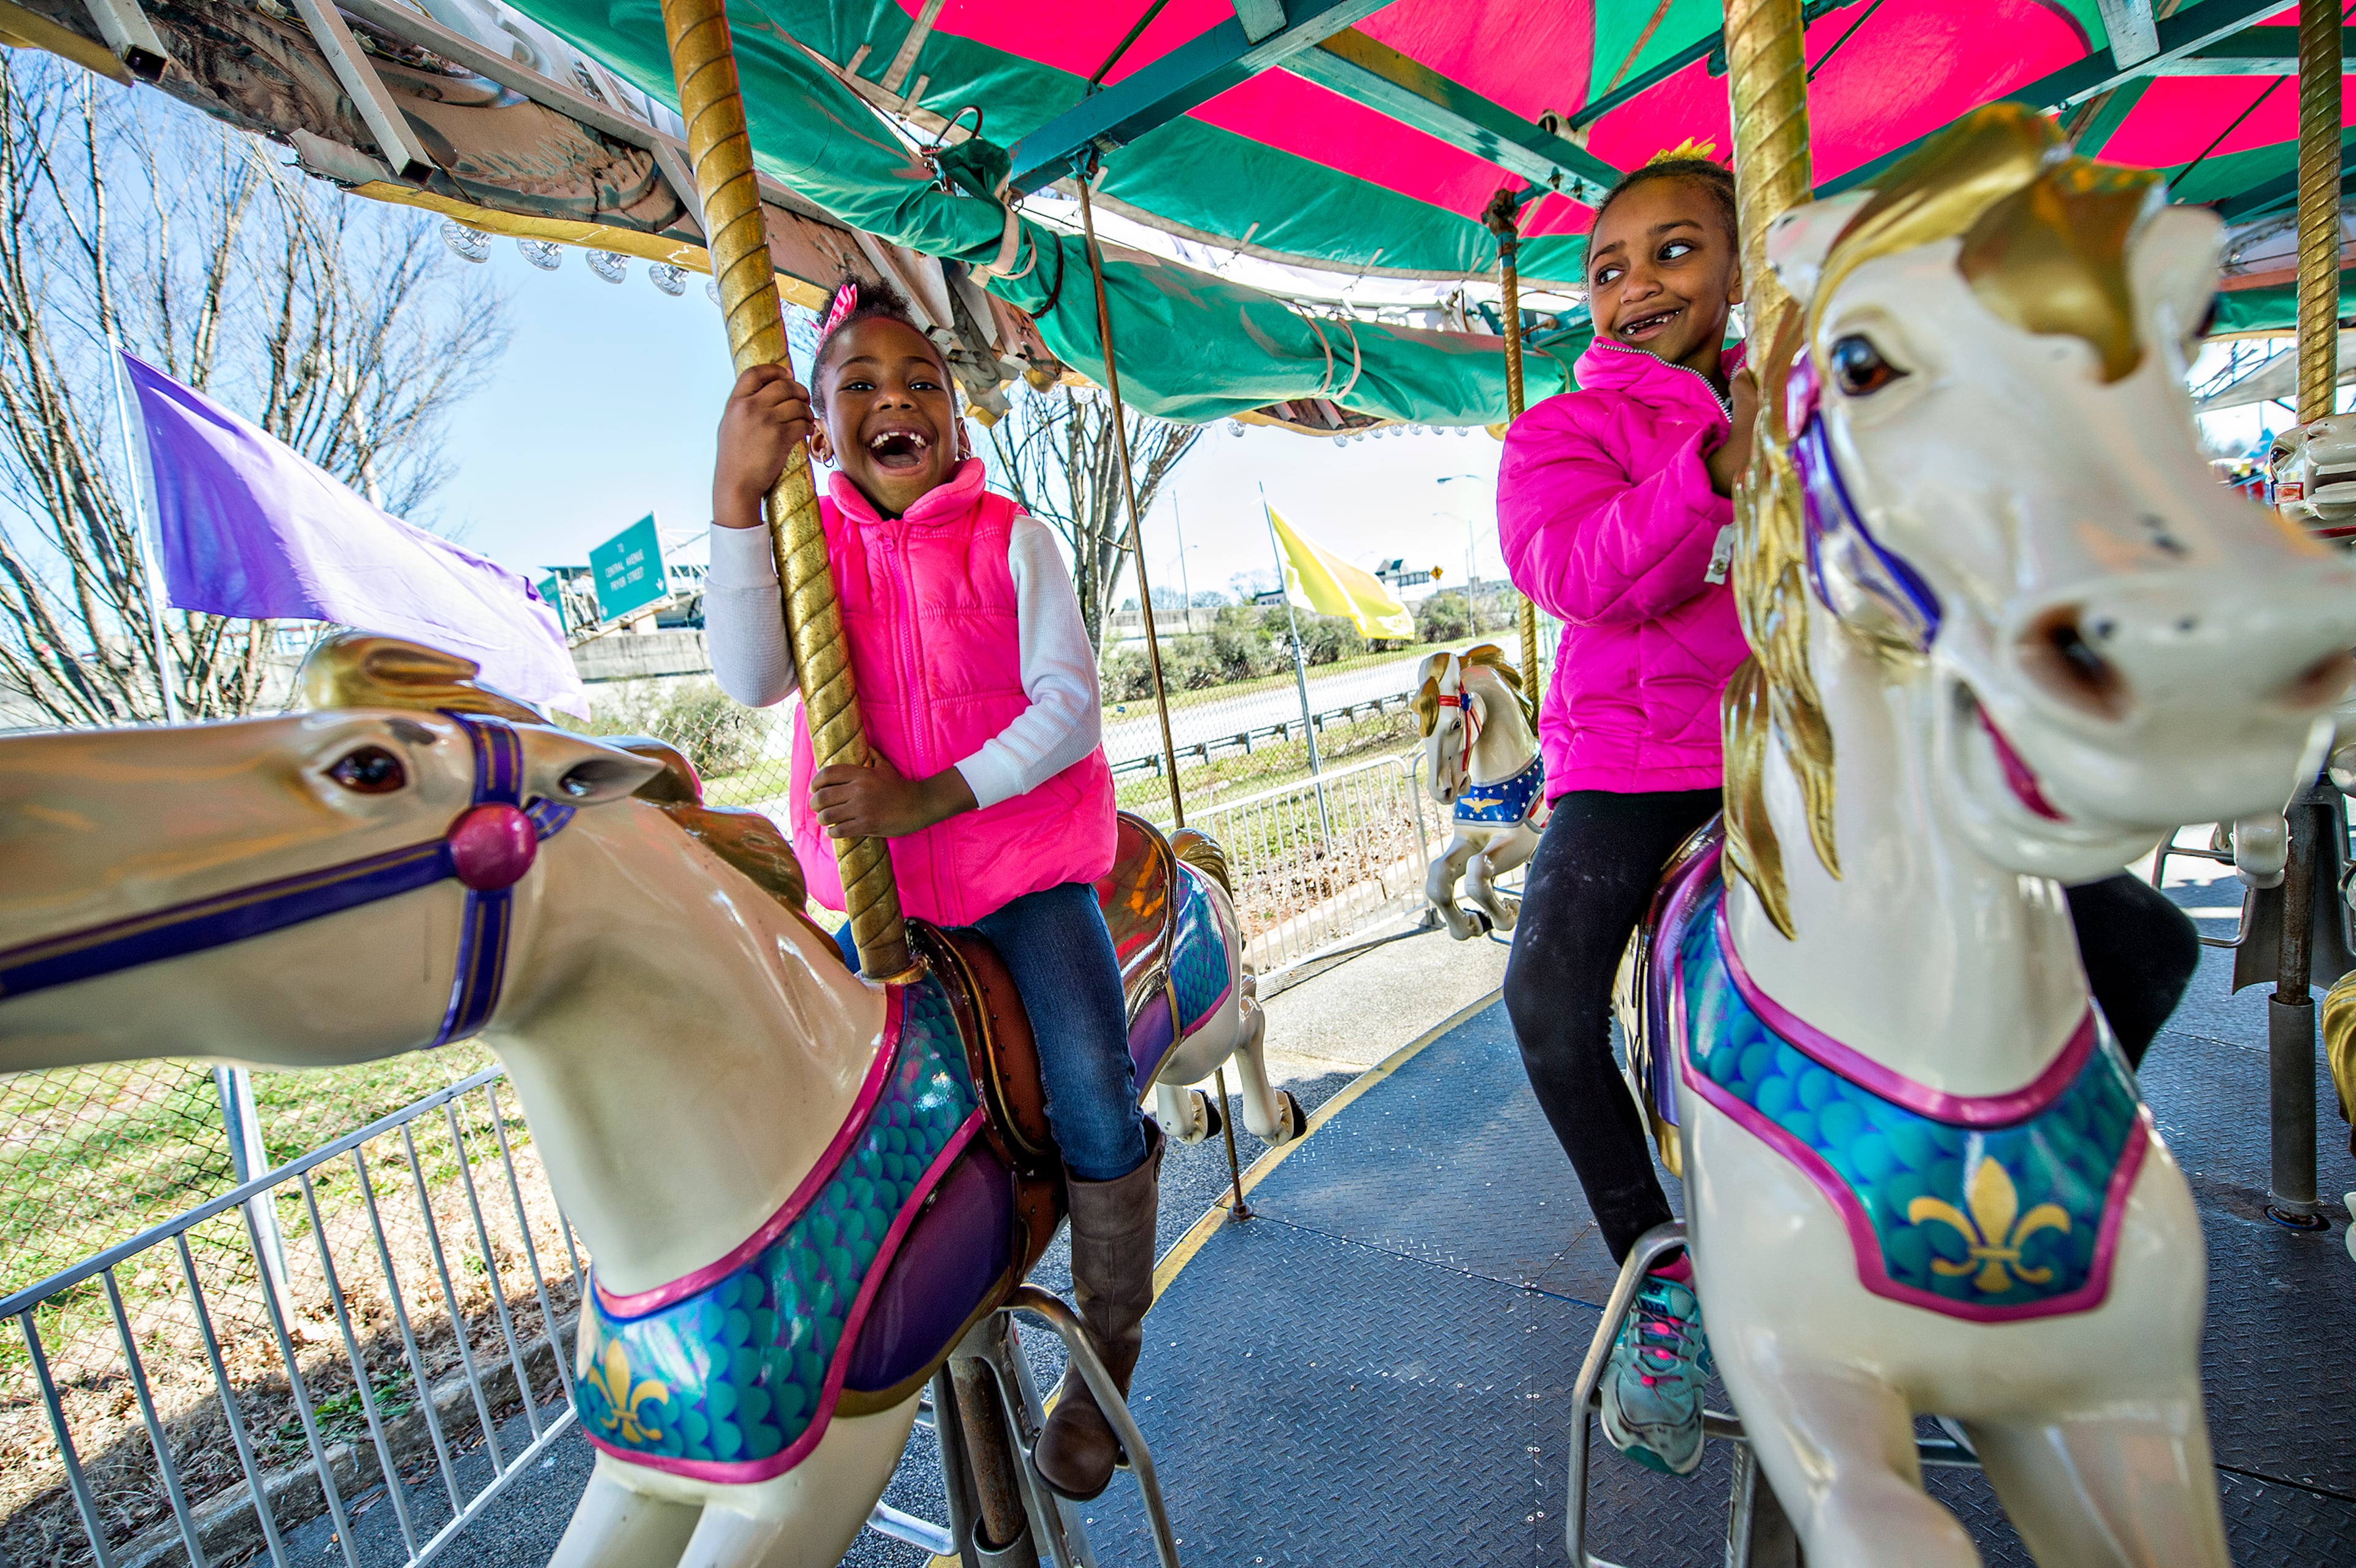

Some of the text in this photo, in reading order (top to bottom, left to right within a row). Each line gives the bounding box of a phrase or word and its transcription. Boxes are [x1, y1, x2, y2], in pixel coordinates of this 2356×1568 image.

[617, 542, 625, 554] TO
[605, 548, 644, 578] CENTRAL AVENUE
[626, 566, 644, 583] STREET
